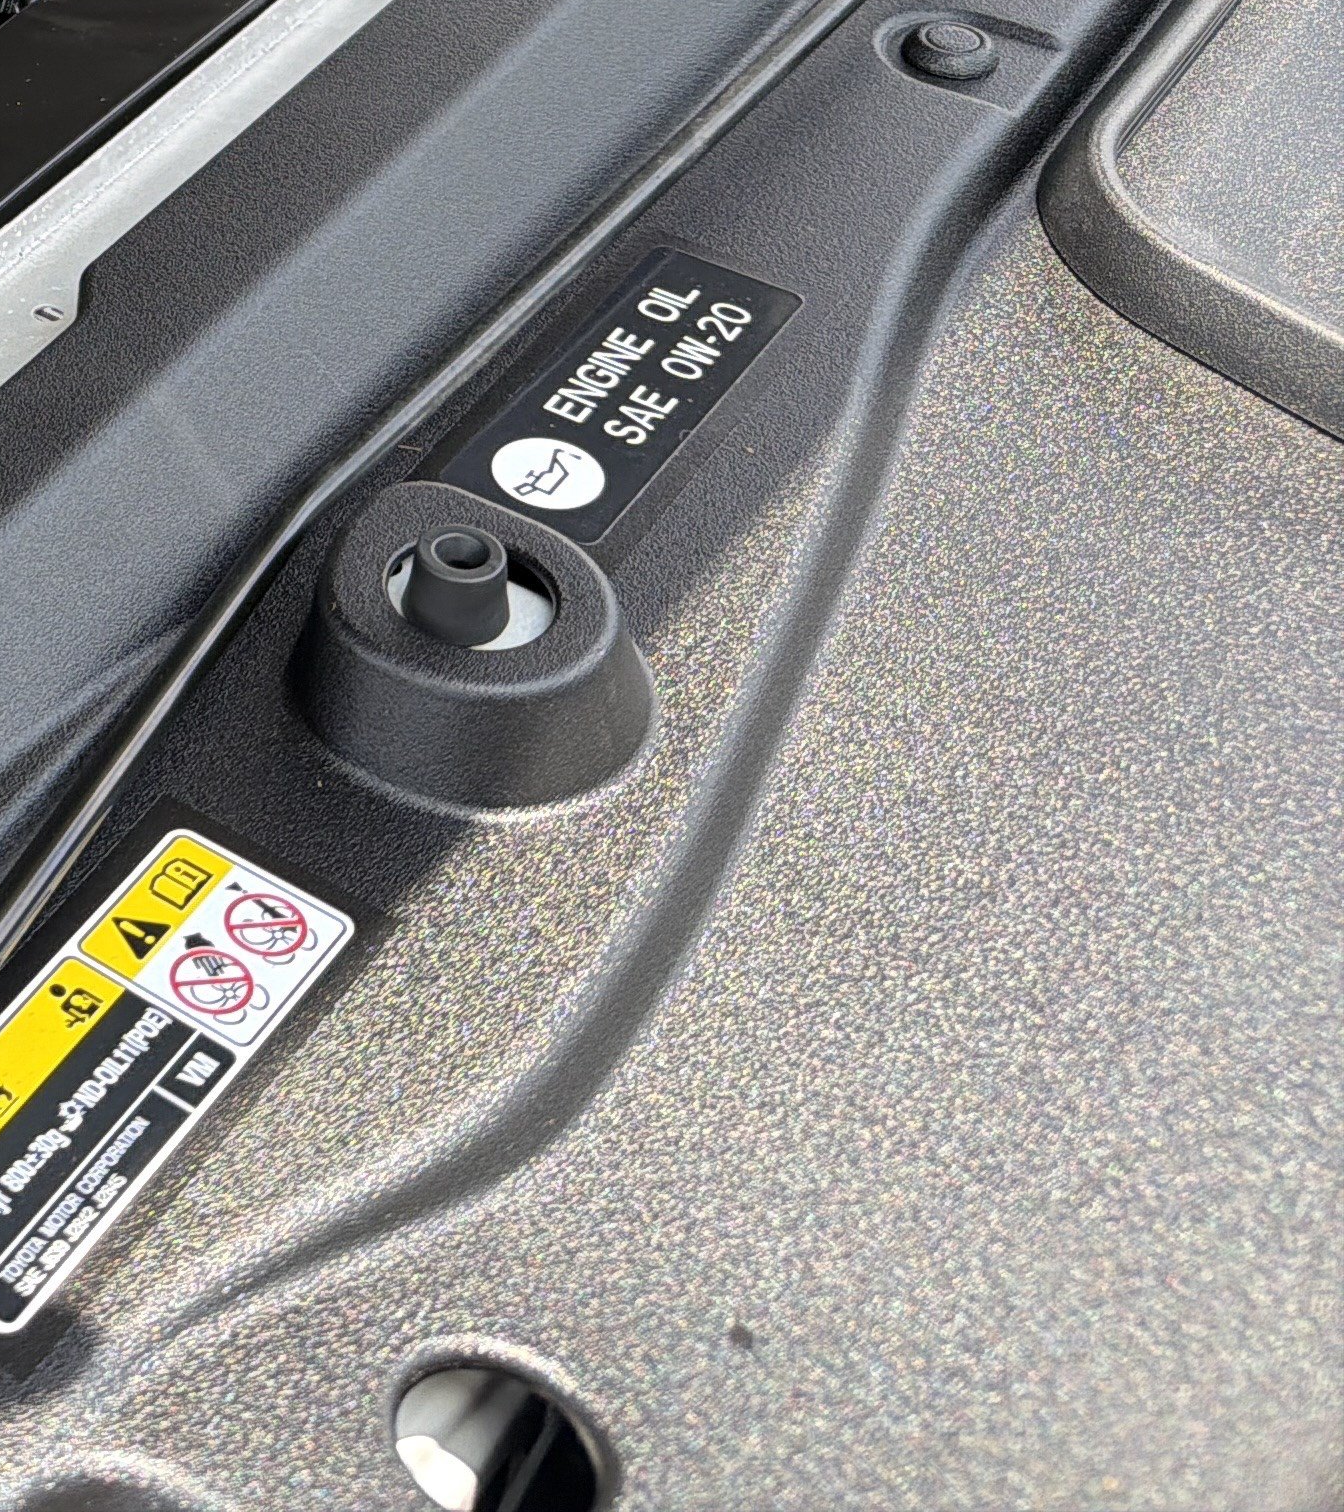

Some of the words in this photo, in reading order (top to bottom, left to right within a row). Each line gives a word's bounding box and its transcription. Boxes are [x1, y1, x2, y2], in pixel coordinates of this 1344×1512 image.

[543, 327, 656, 424] ENGINE
[637, 287, 701, 323] OIL
[603, 384, 679, 446] SAE
[661, 302, 752, 380] 0W-20
[175, 1051, 221, 1087] VM
[37, 1191, 87, 1238] MOTOR
[75, 1115, 151, 1195] CORPORATION
[13, 1264, 48, 1299] SAE
